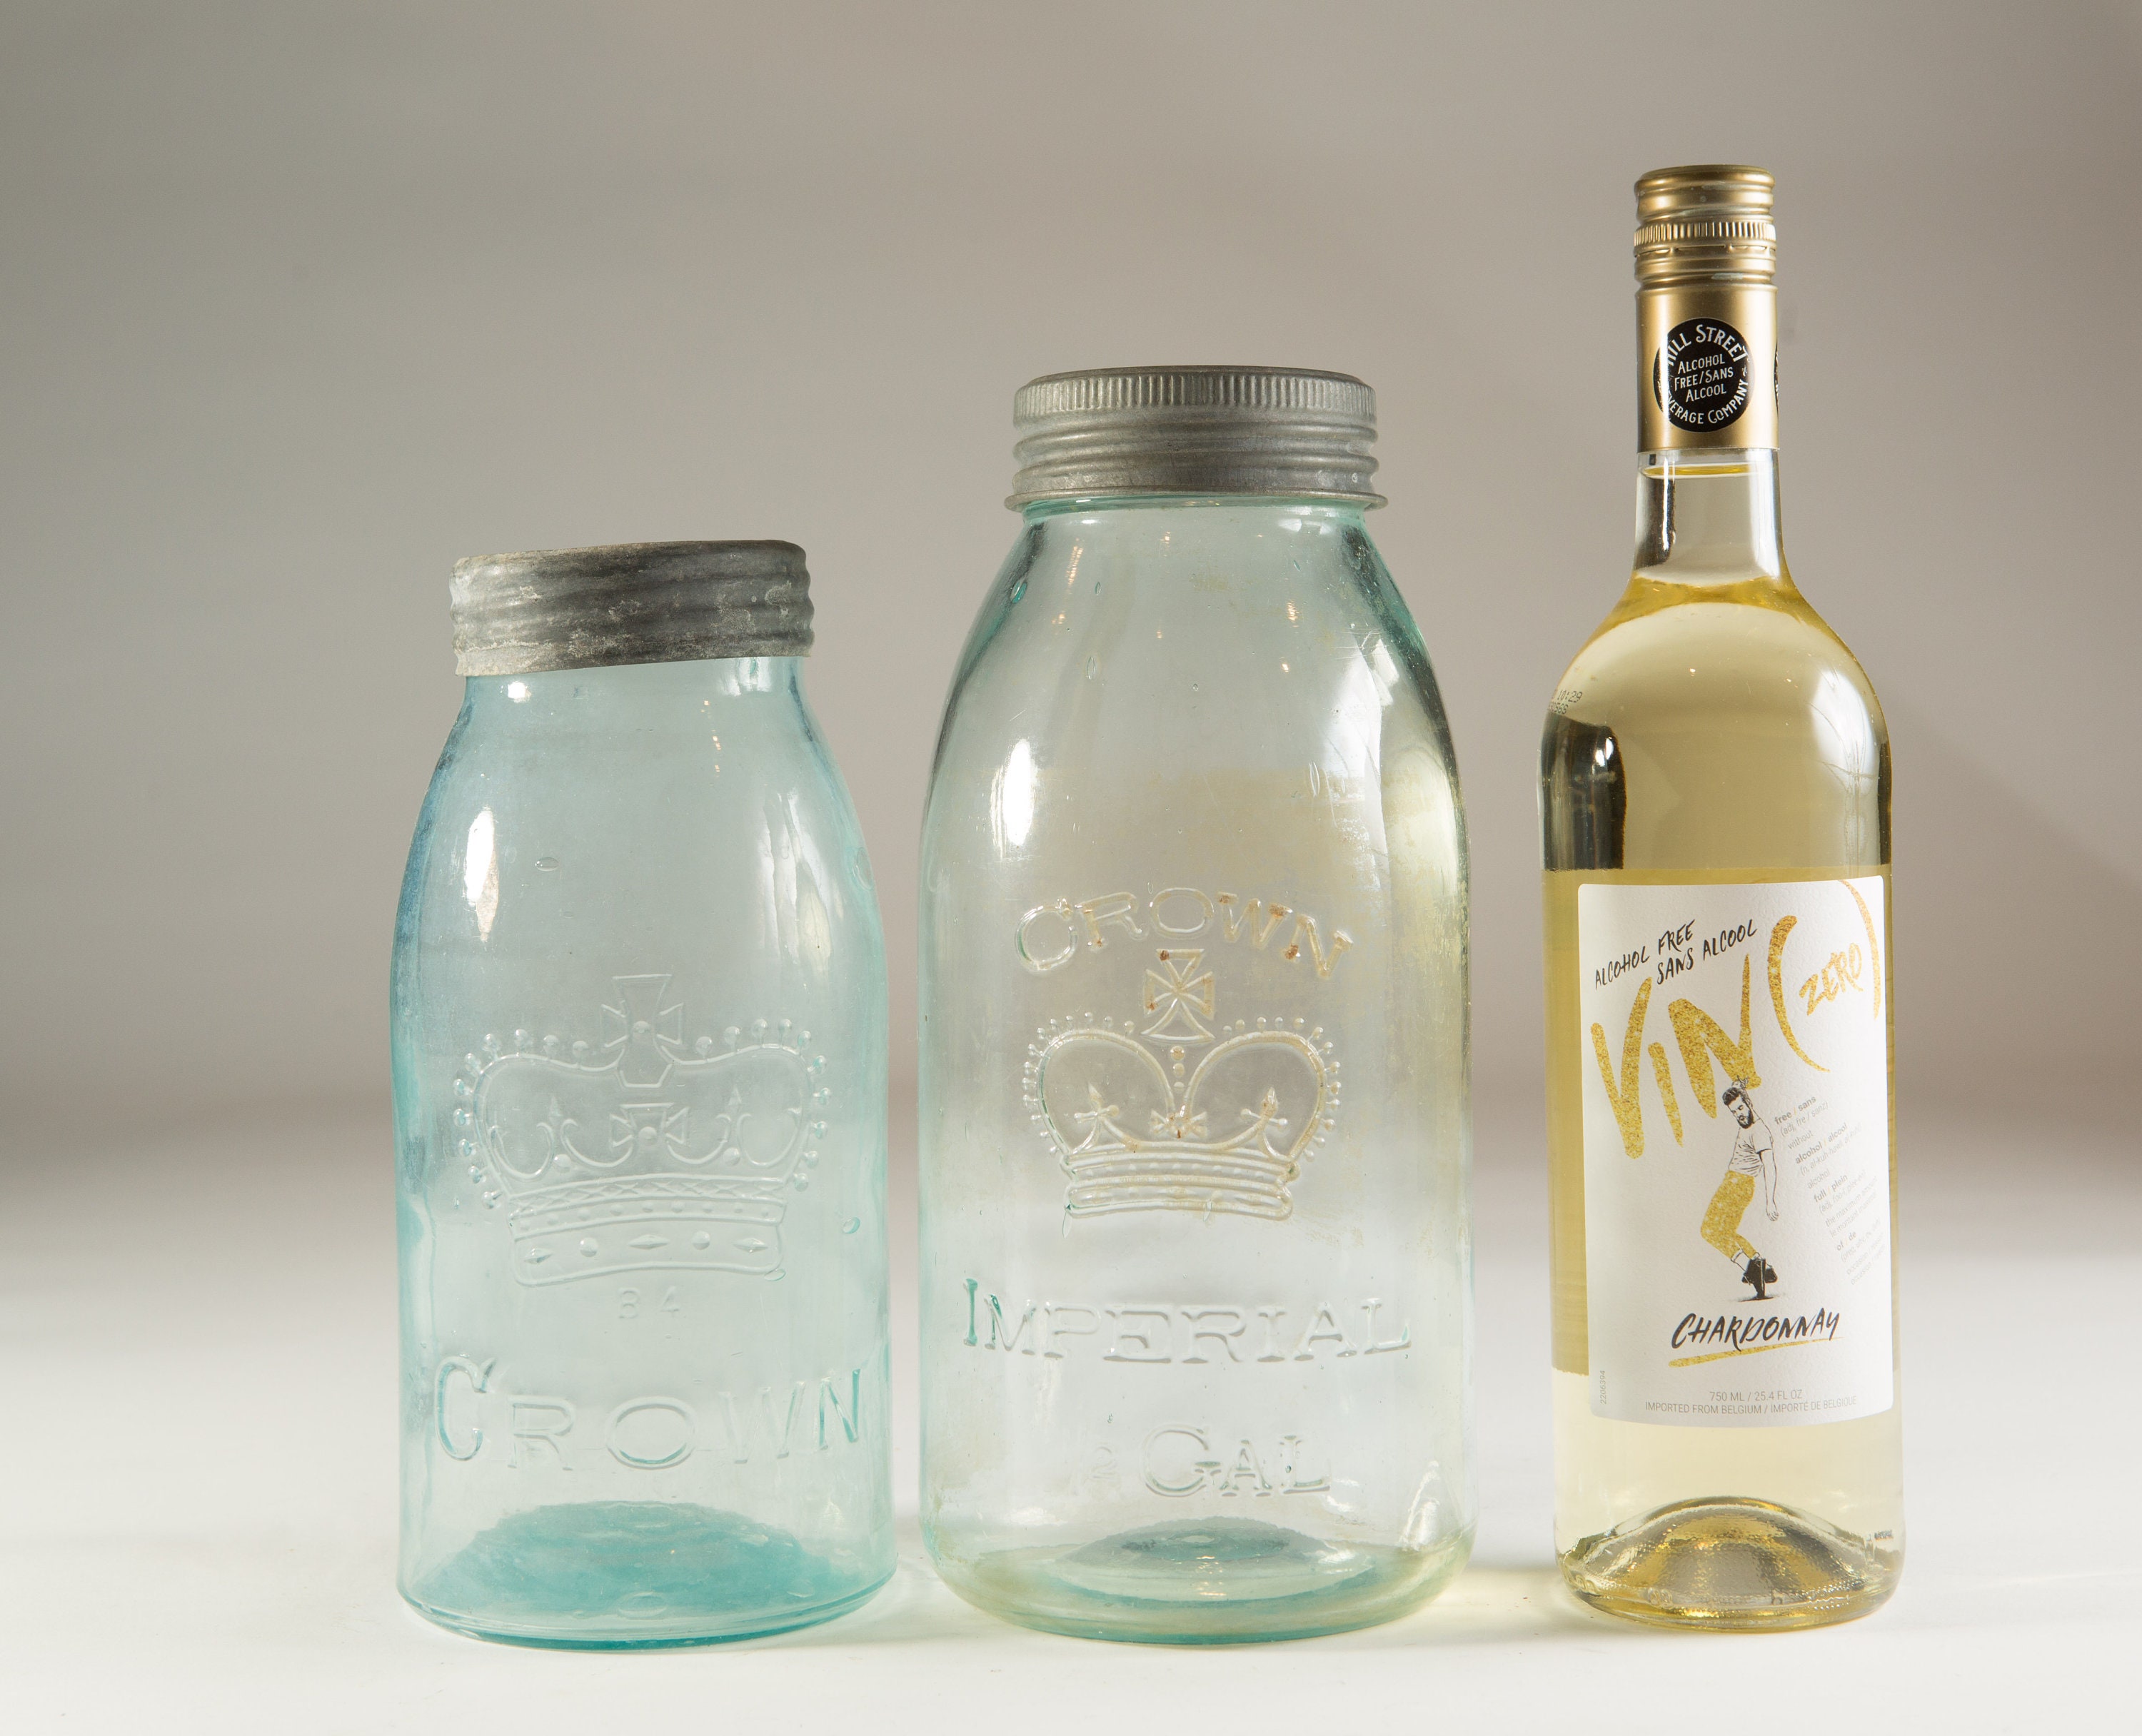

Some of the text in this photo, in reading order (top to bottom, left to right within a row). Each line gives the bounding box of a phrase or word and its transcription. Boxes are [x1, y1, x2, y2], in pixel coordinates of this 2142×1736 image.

[1696, 324, 1749, 363] STREET
[1674, 367, 1734, 392] FREE/SANS
[1678, 353, 1725, 375] ALCOHOL
[1665, 378, 1749, 424] VERAGE COMPANY
[1686, 383, 1726, 403] ALCOOL
[1015, 887, 1354, 980] CROWN
[1595, 919, 1695, 990] ALCOHOL FREE
[1656, 919, 1757, 985] SANS ALCOOL
[1774, 1111, 1792, 1125] free
[1797, 1096, 1817, 1111] sans
[1788, 1130, 1814, 1150] without
[1795, 1141, 1824, 1164] alcohol
[1828, 1122, 1848, 1142] alcool
[1807, 1169, 1831, 1189] alcohol
[1814, 1189, 1827, 1202] full
[1831, 1174, 1848, 1192] plein
[1836, 1240, 1844, 1251] of
[1849, 1231, 1856, 1241] de
[962, 1278, 1412, 1363] IMPERIAL
[1671, 1308, 1840, 1351] CHARDONNAY
[434, 1353, 861, 1470] CROWN
[1645, 1401, 1690, 1413] IMPORTED
[1692, 1403, 1719, 1415] FROM
[1721, 1404, 1762, 1415] BELGIUM
[1771, 1401, 1809, 1413] IMPORTÉ
[1811, 1401, 1821, 1411] DE
[1824, 1396, 1857, 1409] BELGIQUE
[1709, 1391, 1727, 1401] 750
[1730, 1391, 1744, 1401] ML
[1754, 1391, 1775, 1401] 25.4
[1777, 1390, 1787, 1401] FL
[1790, 1389, 1803, 1400] OZ
[1142, 1424, 1329, 1497] GAL
